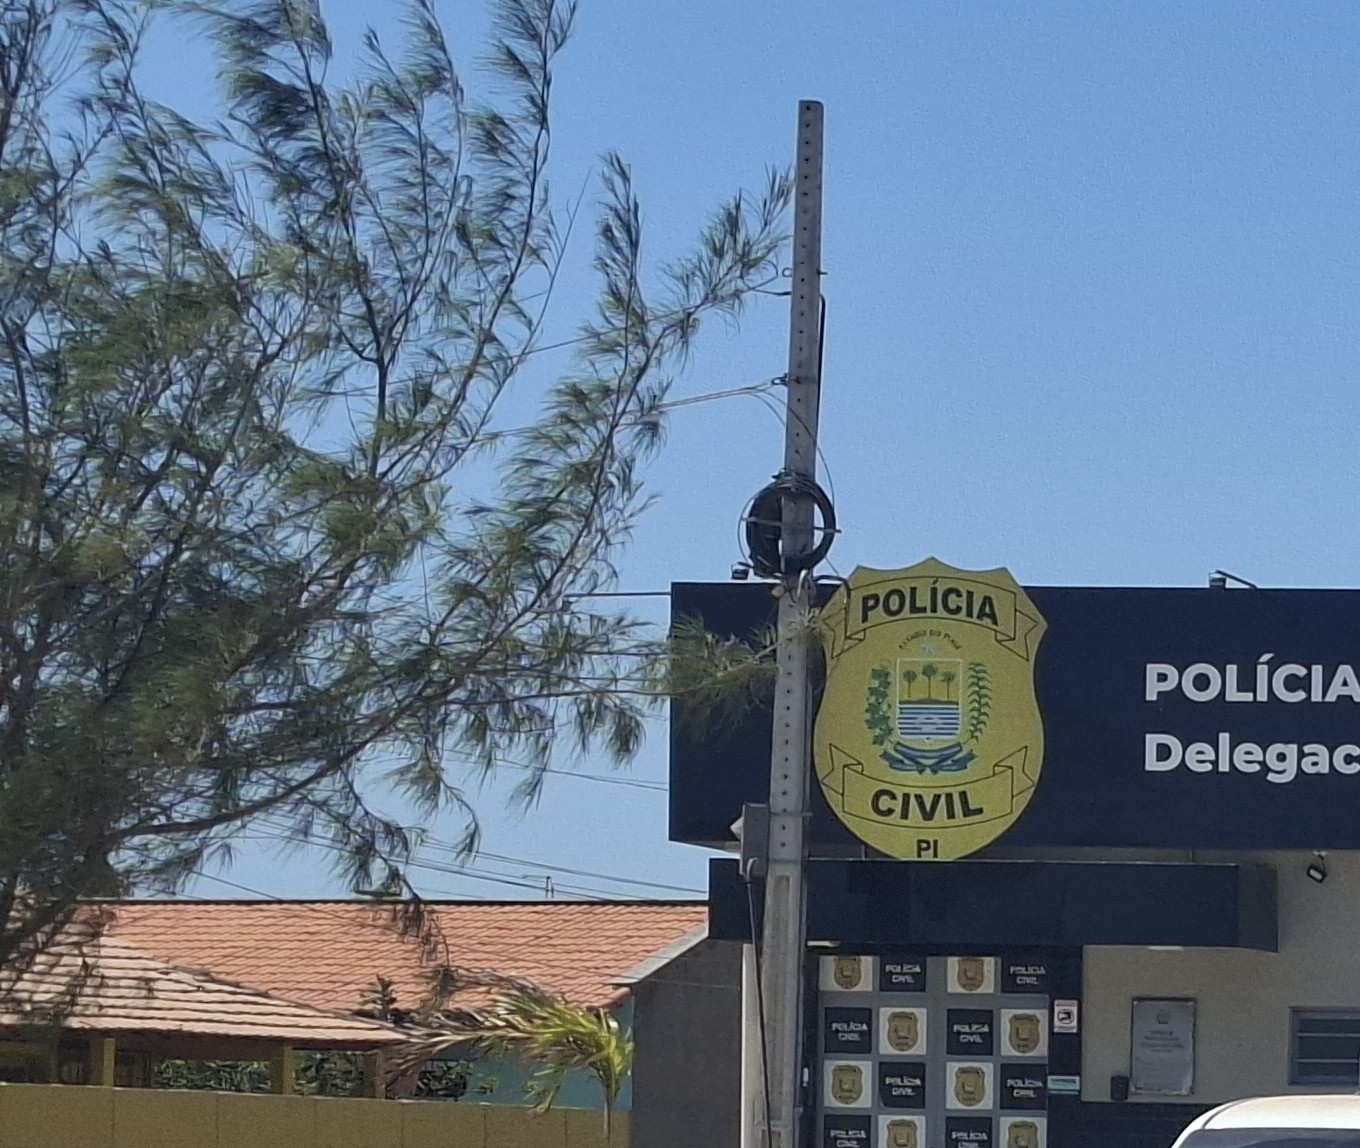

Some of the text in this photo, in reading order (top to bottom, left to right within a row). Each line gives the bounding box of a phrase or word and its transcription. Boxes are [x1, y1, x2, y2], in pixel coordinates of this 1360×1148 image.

[861, 578, 999, 627] POLÍCIA
[870, 789, 984, 822] CIVIL
[916, 838, 938, 859] PI
